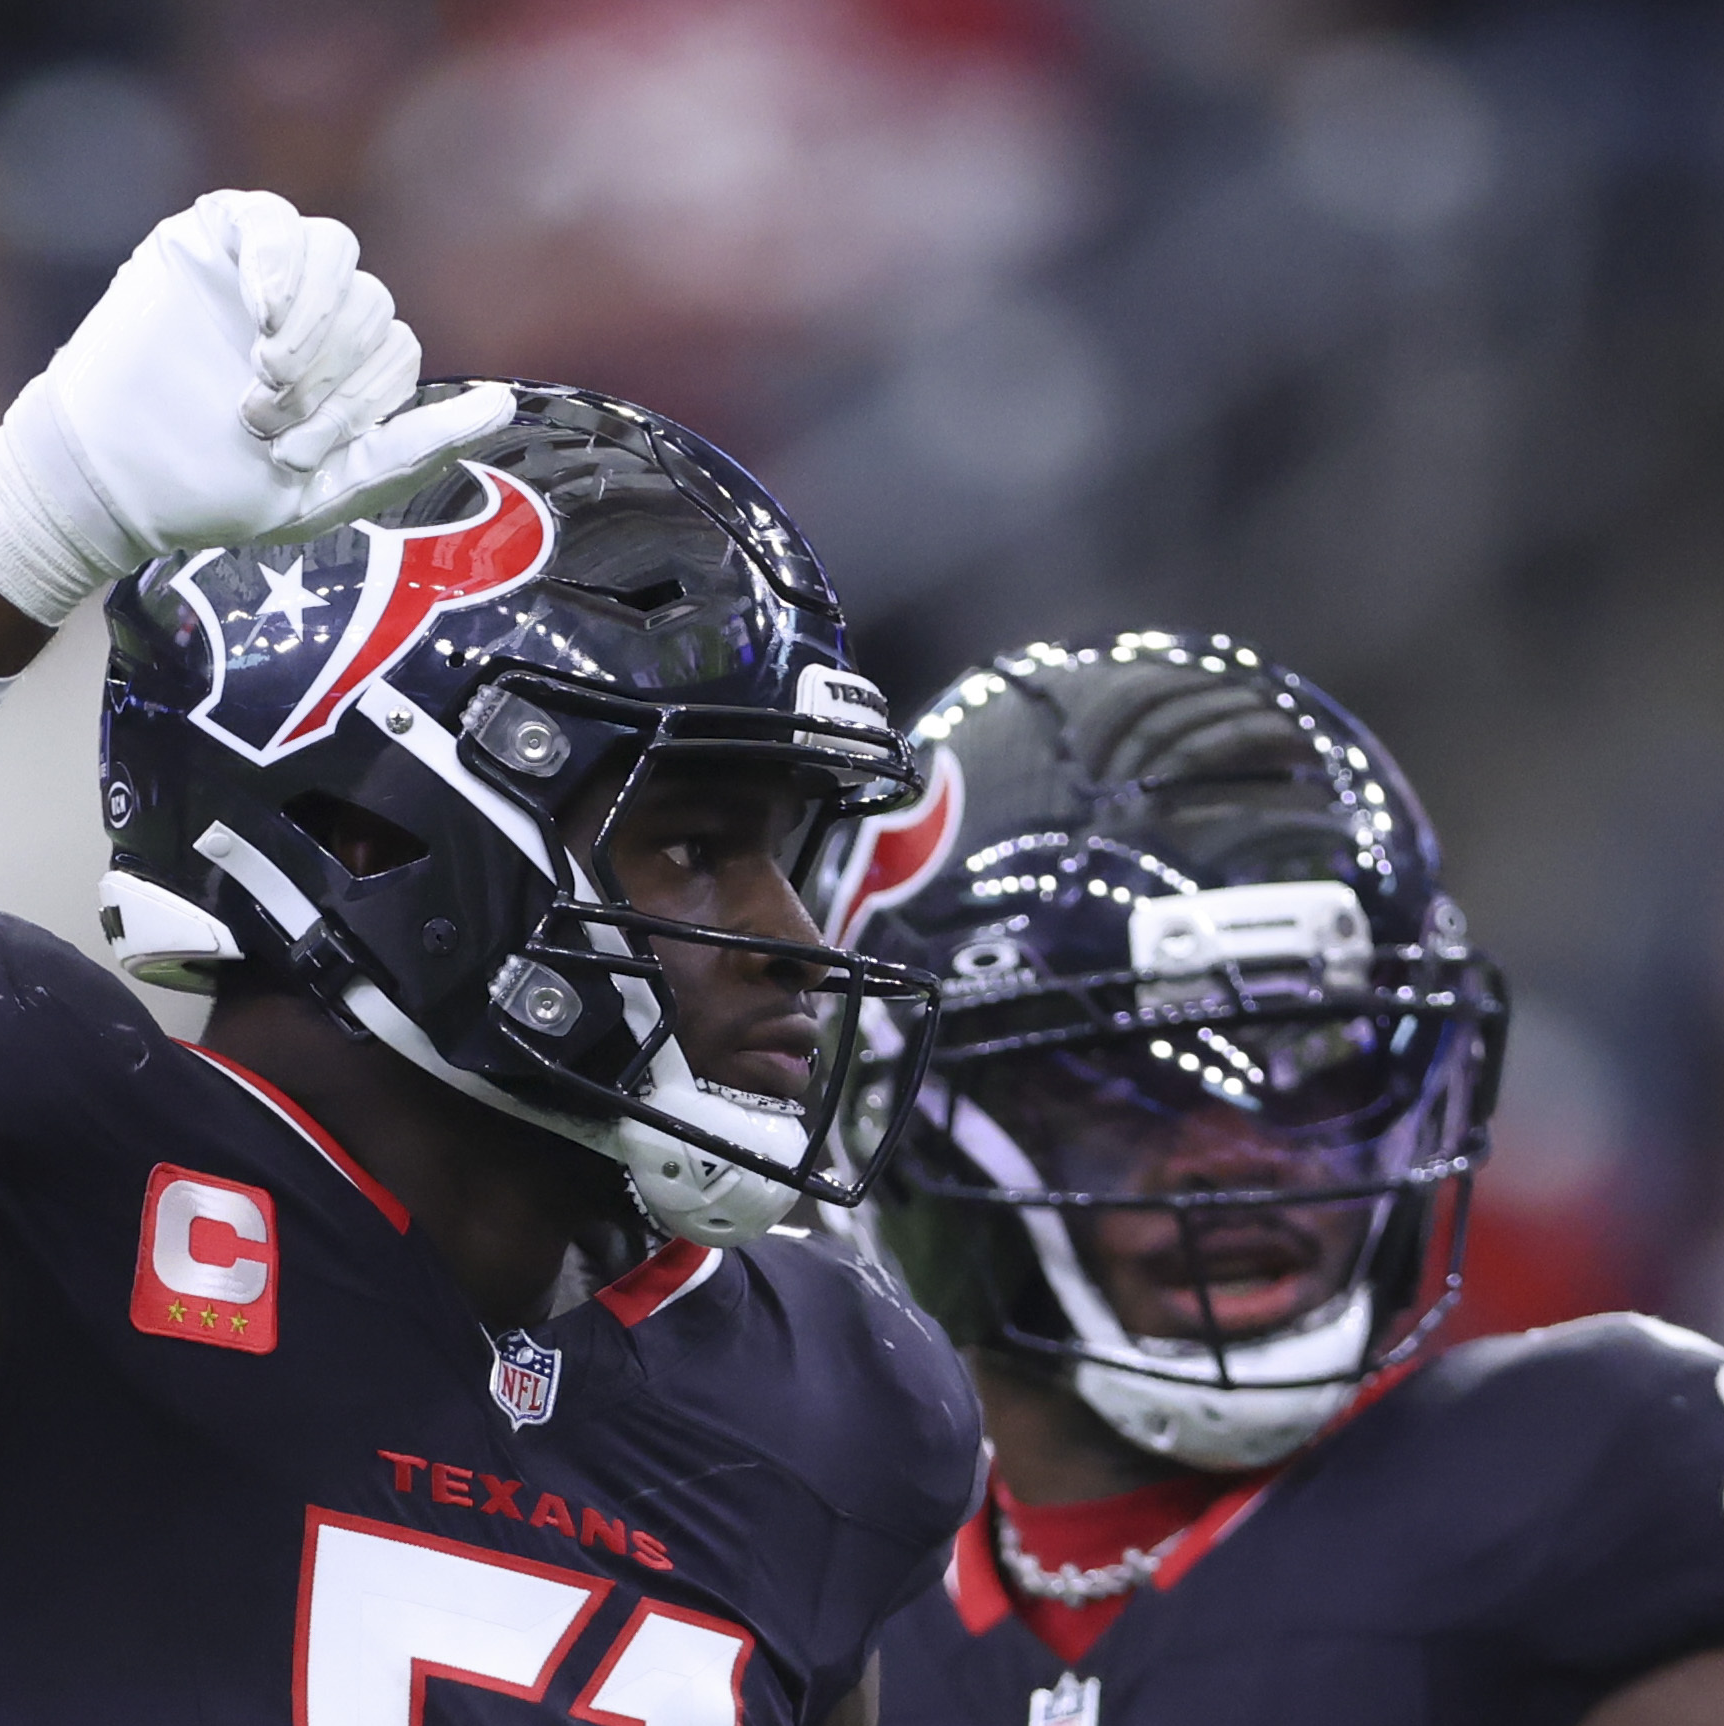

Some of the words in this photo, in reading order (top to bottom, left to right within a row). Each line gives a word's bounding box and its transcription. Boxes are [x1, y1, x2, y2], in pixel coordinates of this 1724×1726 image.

[154, 1179, 269, 1304] C
[501, 1364, 542, 1411] NFL
[377, 1449, 674, 1572] TEXANS
